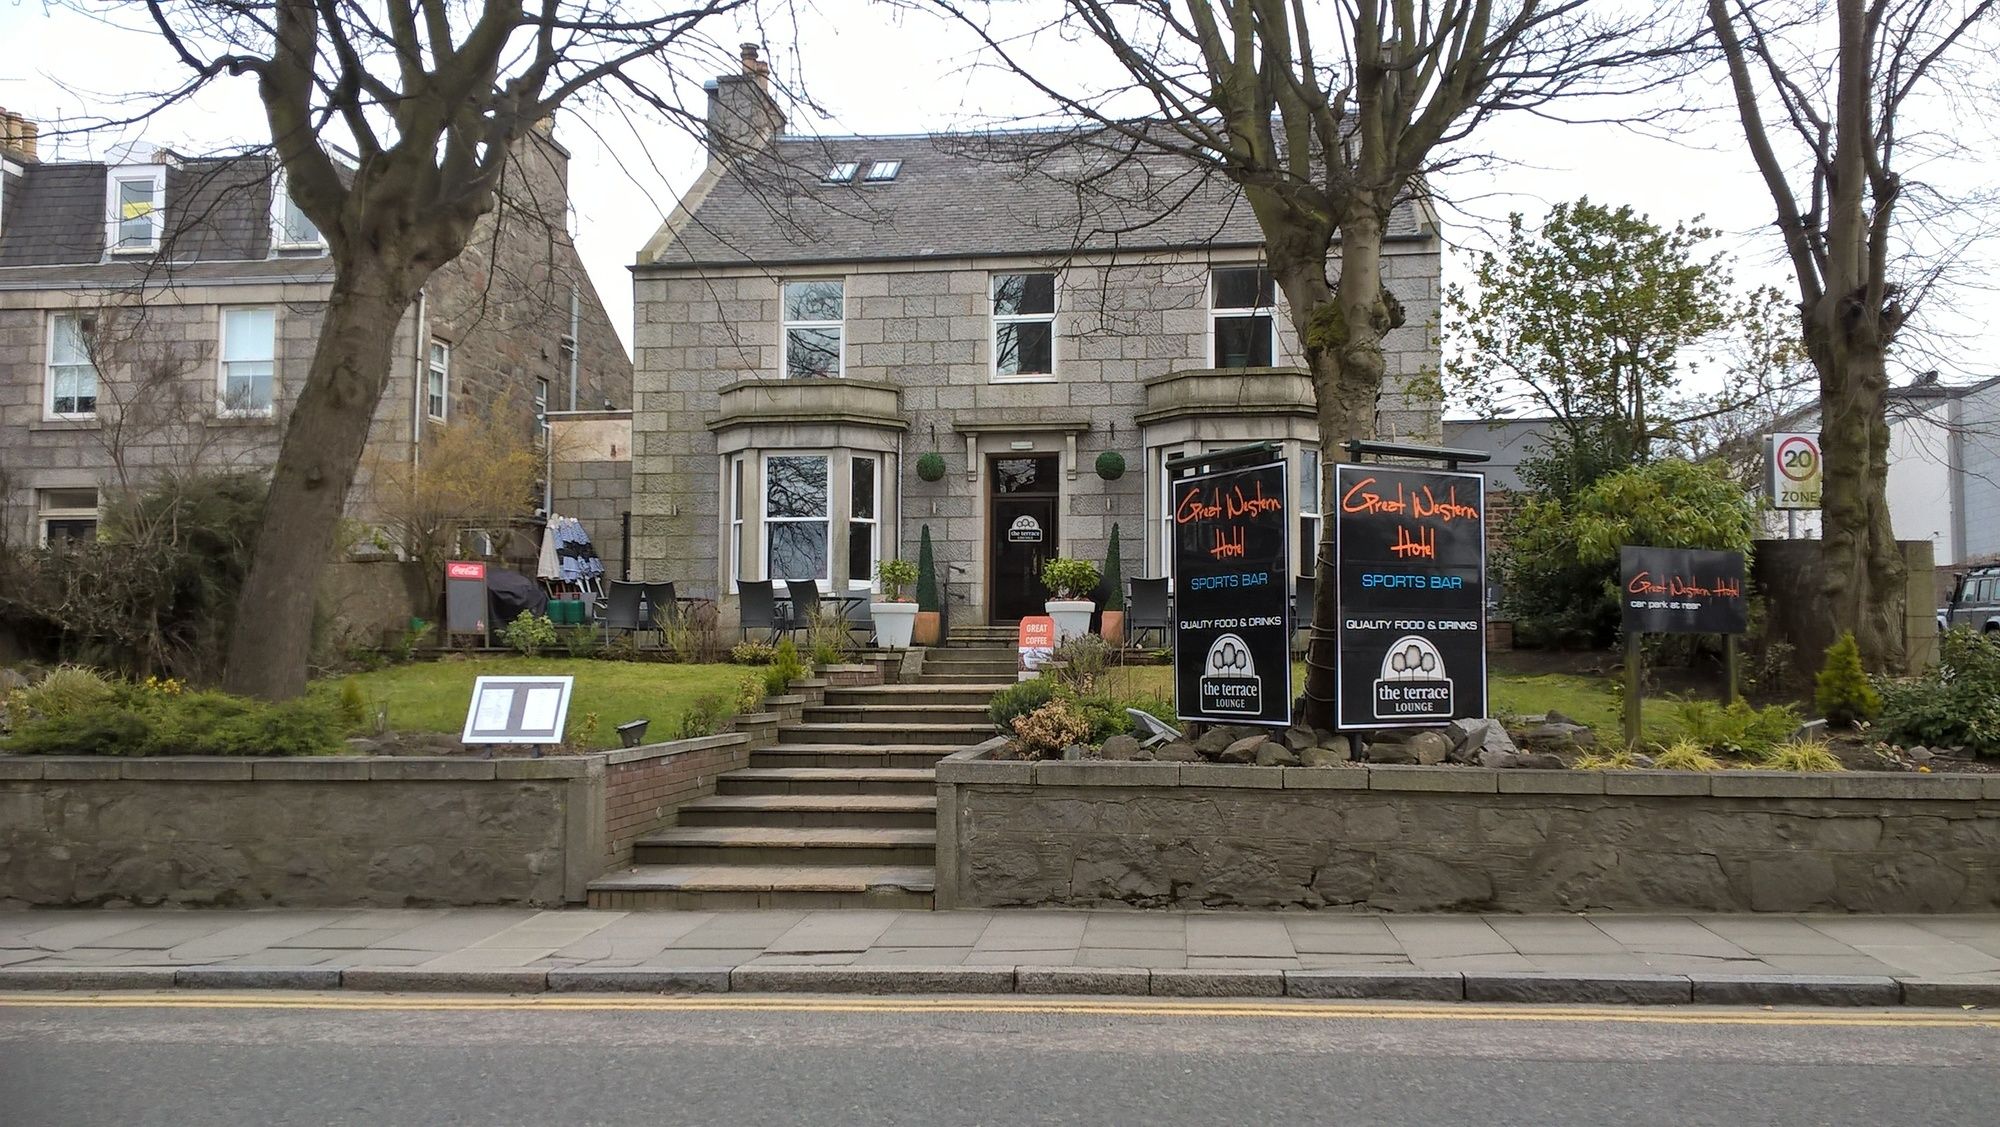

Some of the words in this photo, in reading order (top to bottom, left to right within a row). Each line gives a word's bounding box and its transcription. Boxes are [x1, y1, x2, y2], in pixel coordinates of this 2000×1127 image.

[1784, 449, 1812, 468] 20
[1177, 487, 1222, 523] Great
[1226, 480, 1281, 520] Western
[1343, 478, 1406, 515] Great
[1411, 485, 1479, 521] Western
[1781, 491, 1818, 502] ZONE
[1210, 525, 1244, 560] Hotel
[1390, 525, 1435, 559] Hotel
[1191, 575, 1239, 590] SPORTS
[1242, 572, 1268, 587] BAR
[1362, 574, 1426, 588] SPORTS
[1430, 576, 1462, 589] BAR
[1629, 571, 1667, 595] Great
[1670, 575, 1711, 598] Western
[1712, 577, 1740, 598] Hotel
[1630, 600, 1647, 608] car
[1648, 600, 1669, 610] park
[1669, 601, 1681, 609] at
[1681, 602, 1702, 610] rear
[1026, 624, 1048, 633] GREAT
[1180, 619, 1213, 630] QUALITY
[1214, 618, 1238, 629] FOOD
[1240, 618, 1248, 627] &
[1248, 616, 1282, 627] DRINKS
[1346, 619, 1392, 630] QUALITY
[1394, 620, 1425, 630] FOOD
[1427, 621, 1437, 630] &
[1438, 621, 1478, 631] DRINKS
[1025, 636, 1048, 645] COFFEE
[1204, 681, 1220, 696] the
[1221, 683, 1258, 697] terrace
[1379, 685, 1401, 700] the
[1403, 686, 1449, 700] terrace
[1215, 699, 1246, 709] LOUNGE
[1395, 701, 1434, 712] LOUNGE
